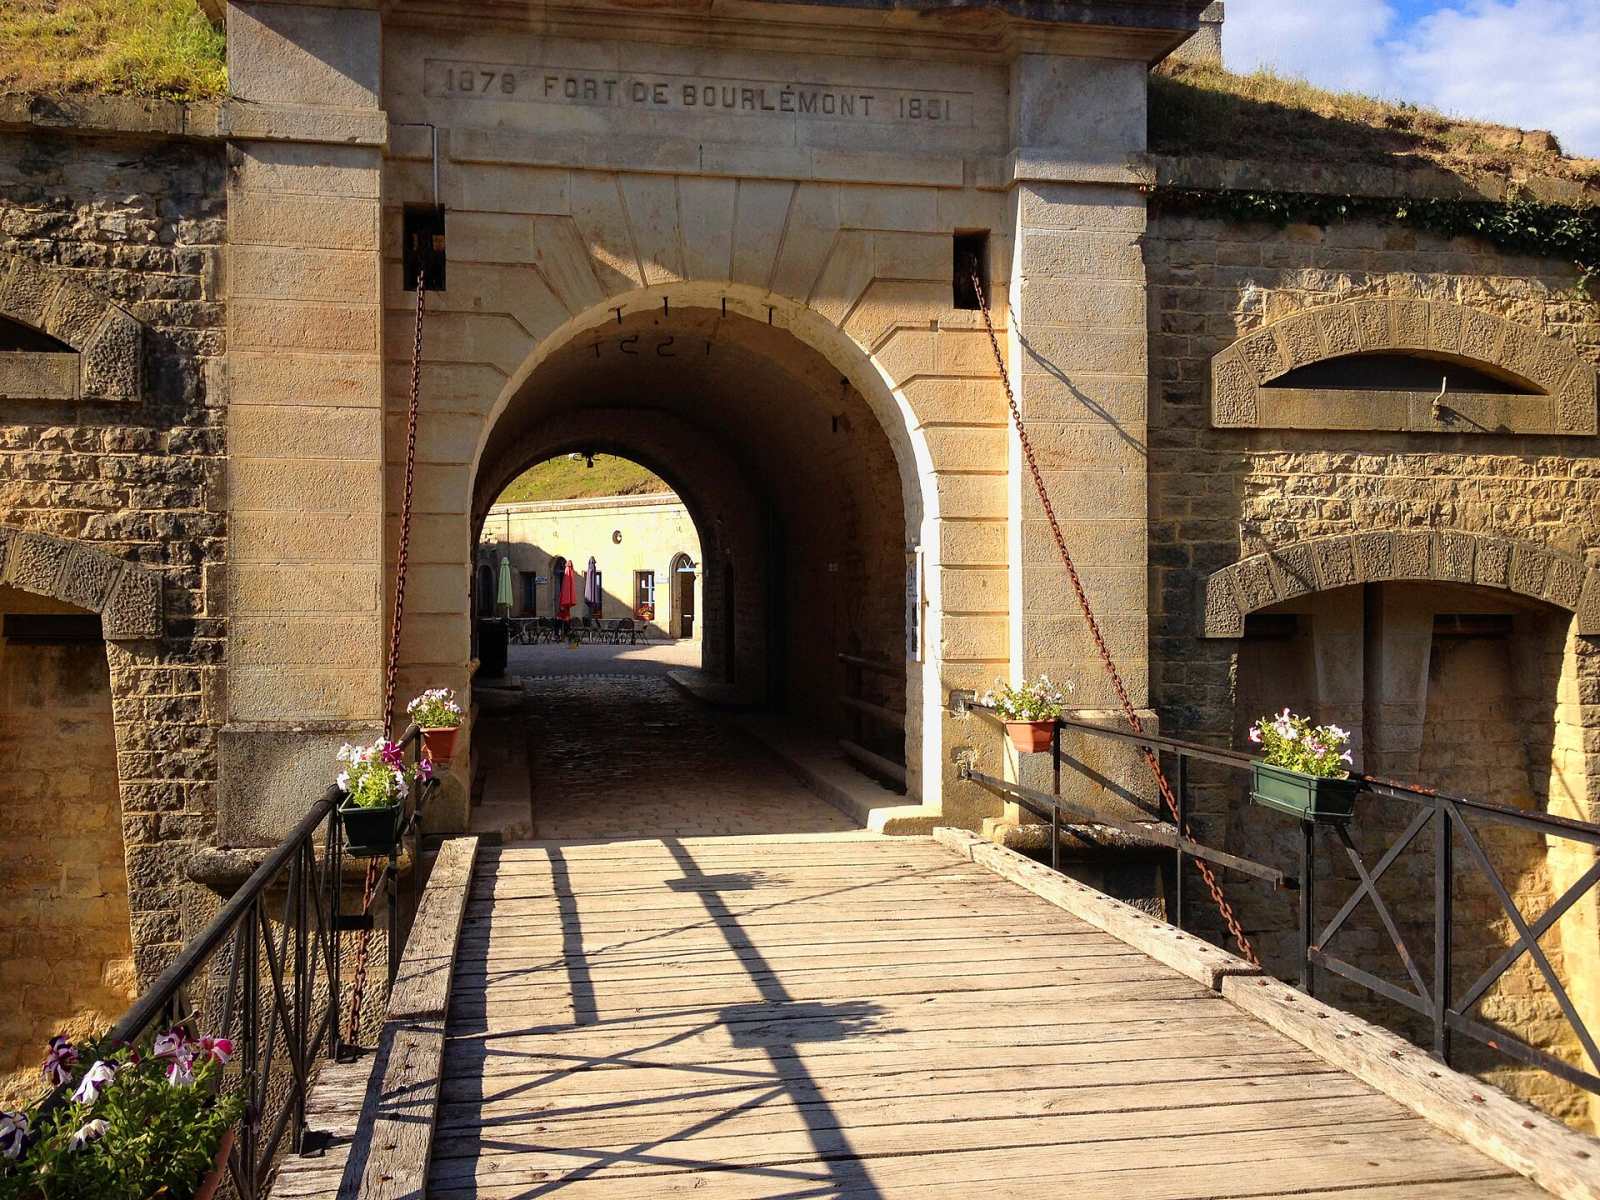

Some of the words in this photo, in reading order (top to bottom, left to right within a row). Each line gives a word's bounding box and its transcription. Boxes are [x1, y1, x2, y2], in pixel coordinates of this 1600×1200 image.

[544, 76, 617, 100] FORT
[632, 82, 669, 105] DE
[683, 84, 874, 116] BOURLÉMONT
